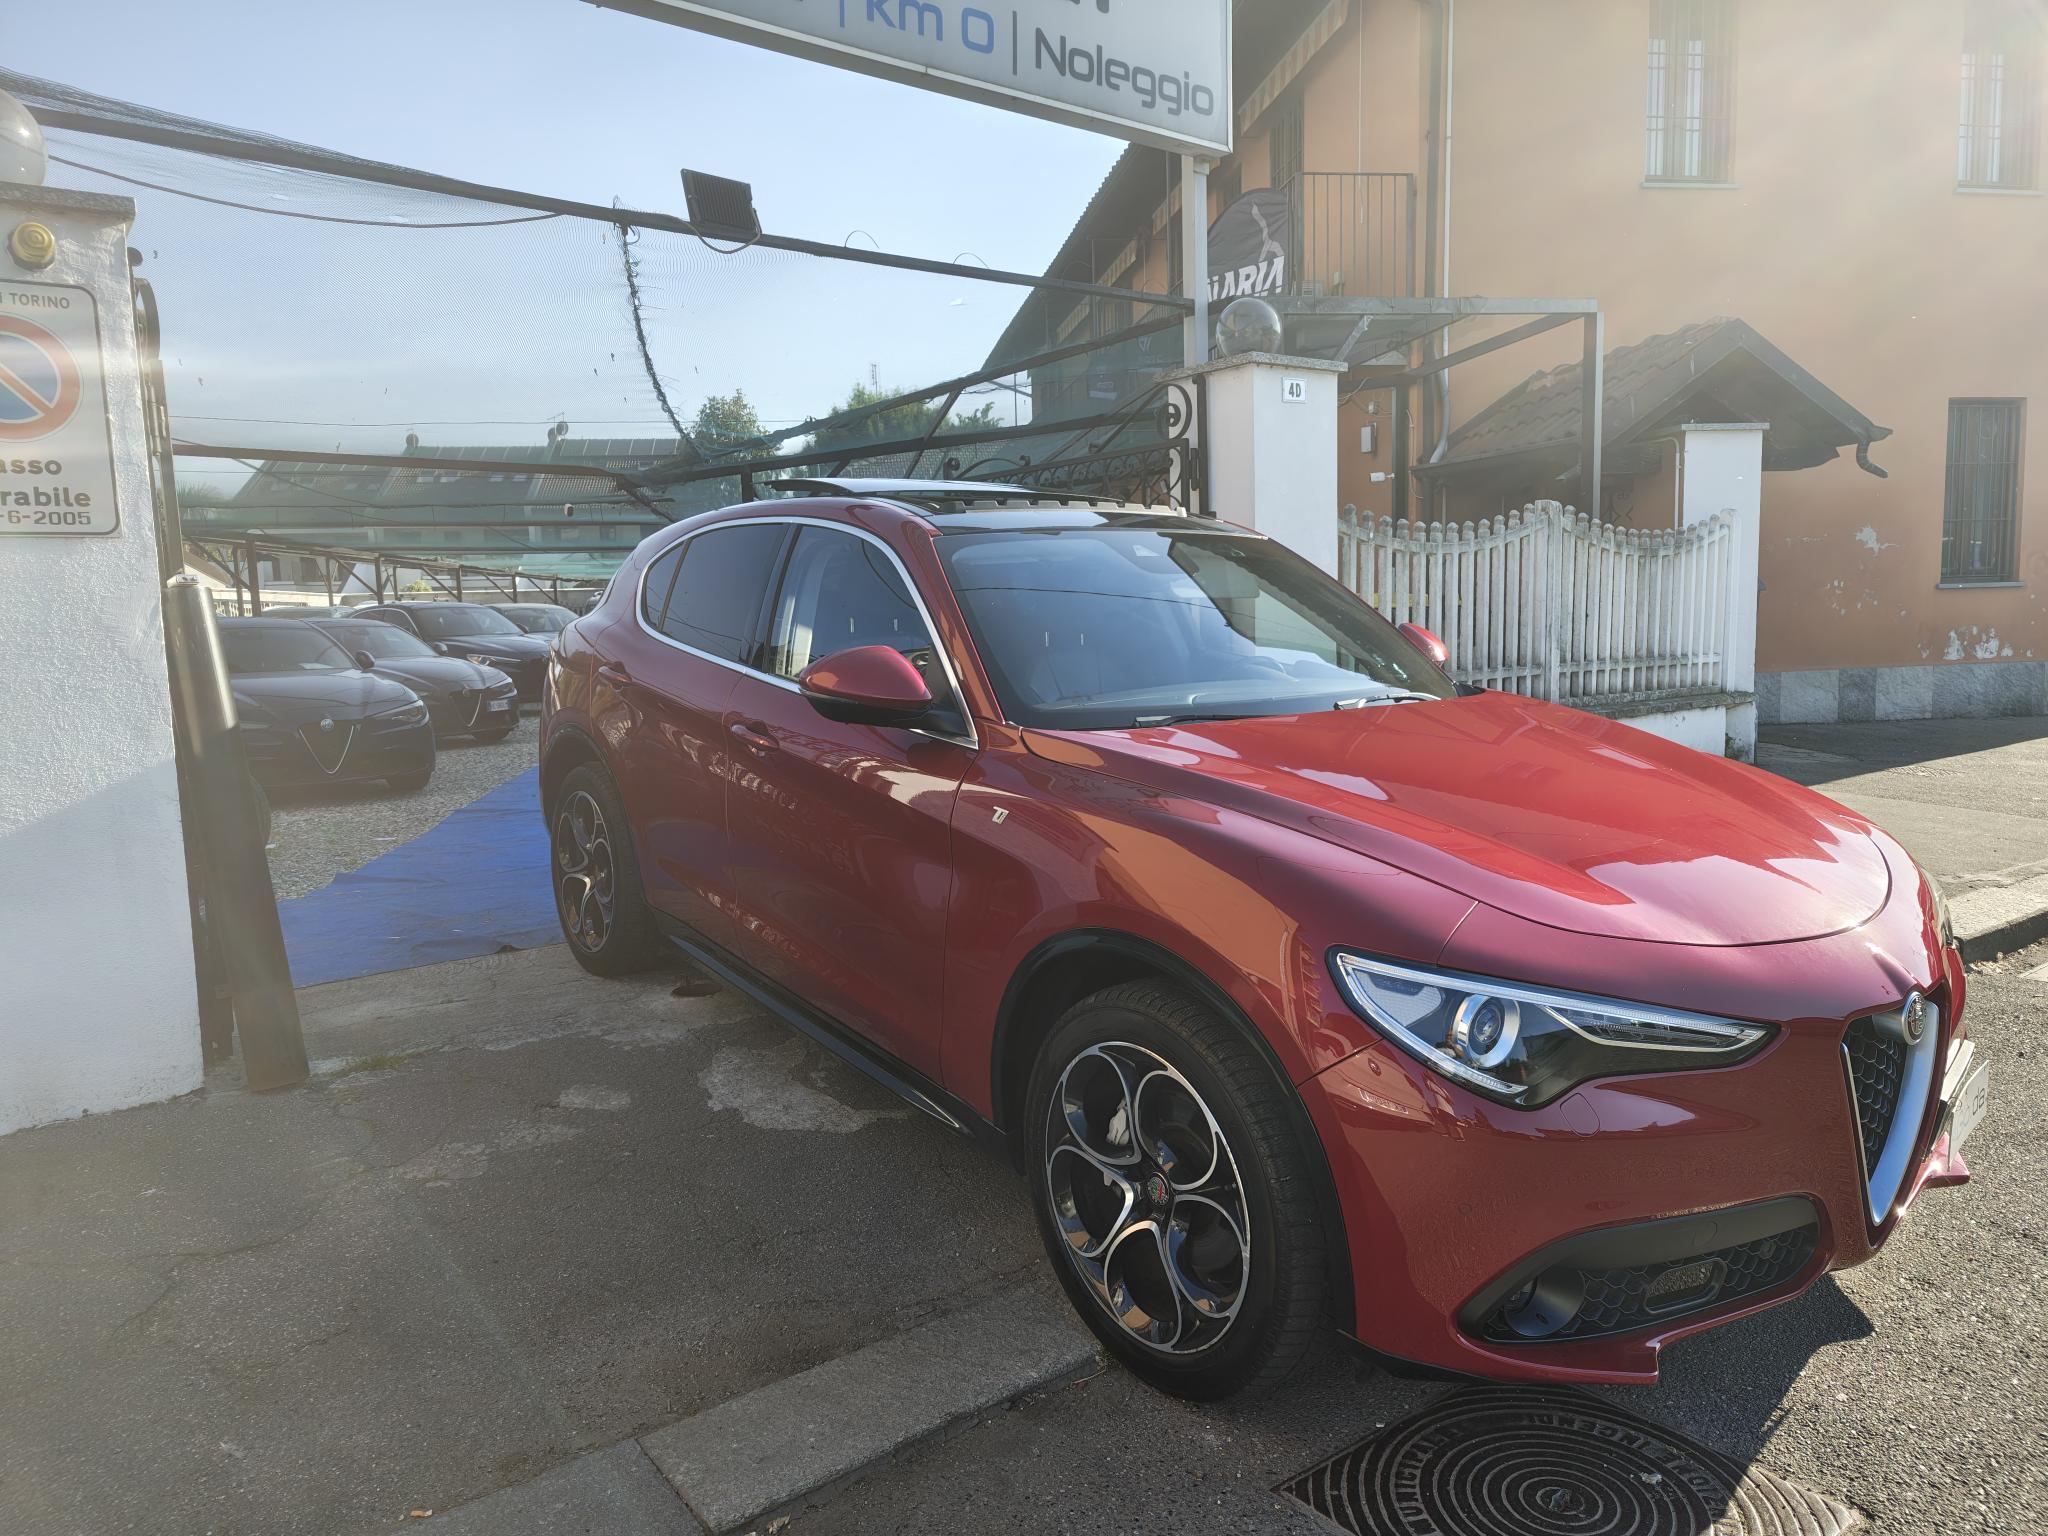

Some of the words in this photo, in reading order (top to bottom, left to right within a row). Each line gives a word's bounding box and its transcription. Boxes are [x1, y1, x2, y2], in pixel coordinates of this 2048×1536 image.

[1035, 27, 1214, 116] Noleggio
[9, 292, 70, 309] TORINO
[1288, 382, 1302, 398] 4D
